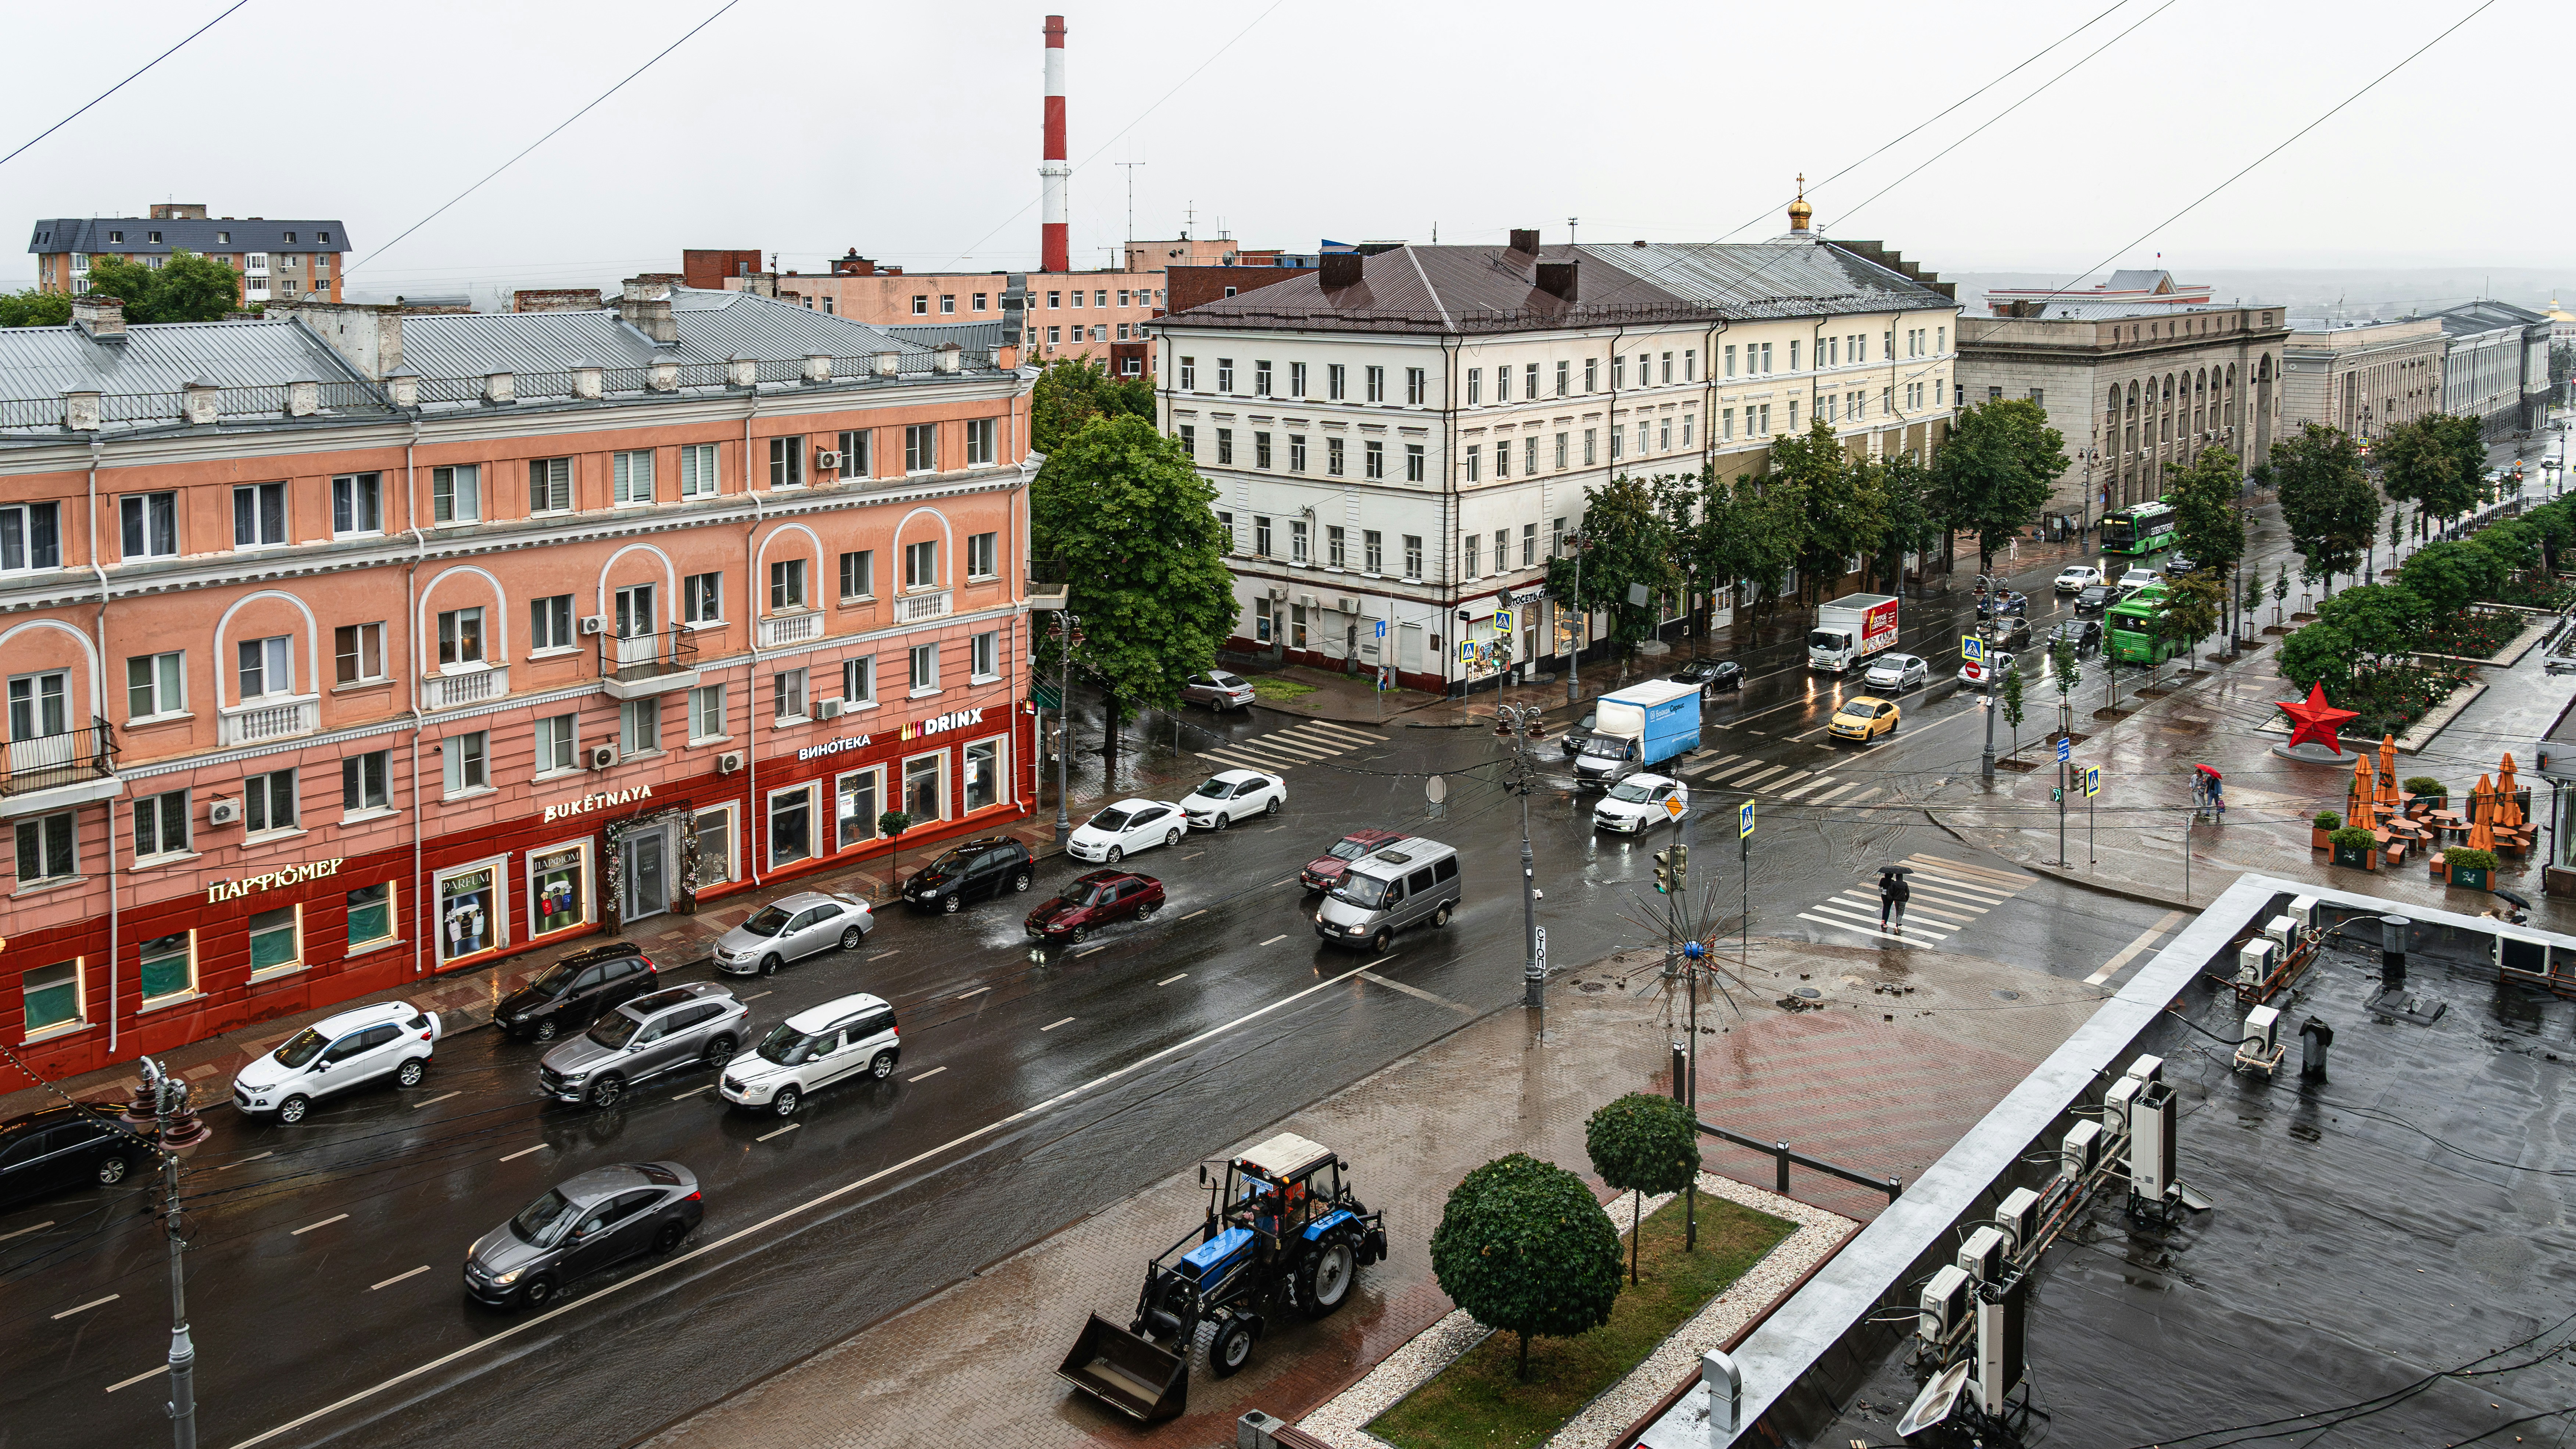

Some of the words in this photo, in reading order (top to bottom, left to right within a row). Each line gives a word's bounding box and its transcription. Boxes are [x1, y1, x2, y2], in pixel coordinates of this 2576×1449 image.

[1499, 592, 1537, 608] ТОСЕТЬ
[1874, 613, 1887, 624] ОСТРОВ
[1670, 703, 1684, 713] Сервис
[925, 707, 983, 735] DRINX
[799, 734, 871, 760] ВИНОТЕКА
[534, 852, 579, 870] ПАРФЮМ
[208, 858, 343, 903] ПАРФЮМЕР
[443, 872, 489, 892] PARFUM
